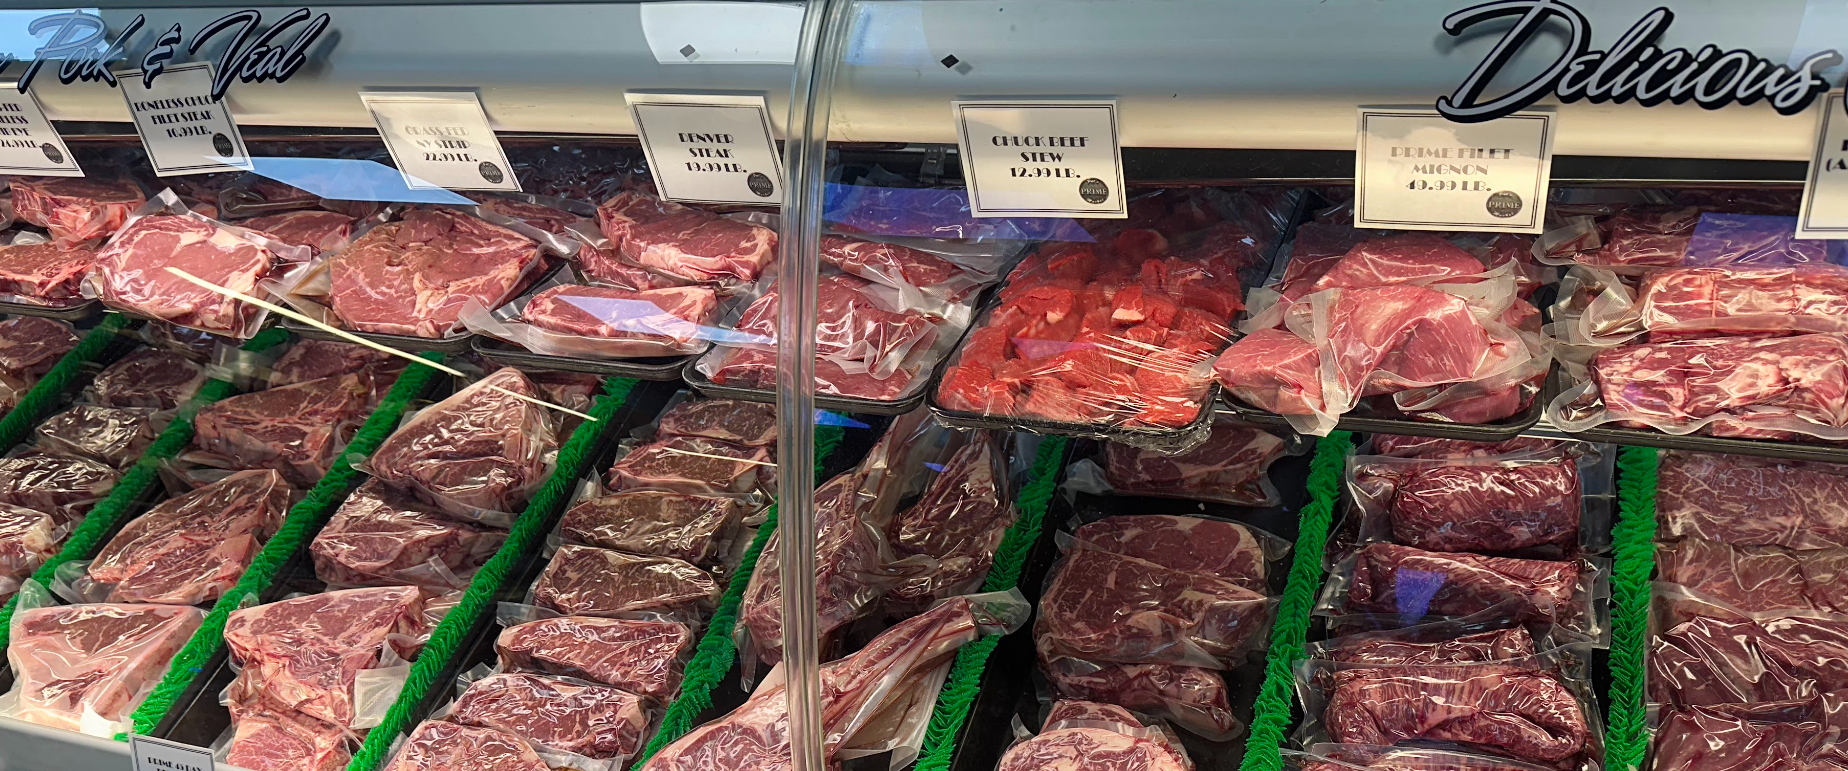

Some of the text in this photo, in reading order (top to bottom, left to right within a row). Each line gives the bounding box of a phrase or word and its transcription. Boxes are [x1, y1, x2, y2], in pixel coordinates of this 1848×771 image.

[17, 8, 331, 100] Pork & Veal
[1436, 0, 1841, 123] Delicious
[134, 97, 185, 112] BONELESS
[151, 109, 215, 125] FILET STEAK
[194, 125, 212, 136] LB.
[678, 132, 735, 144] DENVER
[991, 135, 1090, 147] CHUCK BEEF
[435, 139, 471, 149] STRIP
[456, 153, 478, 162] LB.
[688, 147, 735, 158] STEAK
[1020, 151, 1065, 162] STEW
[1390, 146, 1515, 160] PRIME FILET
[685, 162, 748, 173] 19.99 LB.
[1010, 167, 1081, 178] 12.99 LB.
[1411, 163, 1489, 175] MIGNON
[1405, 179, 1492, 192] 49.99 LB.
[1080, 187, 1108, 196] PRIME
[1488, 200, 1522, 209] PRIME
